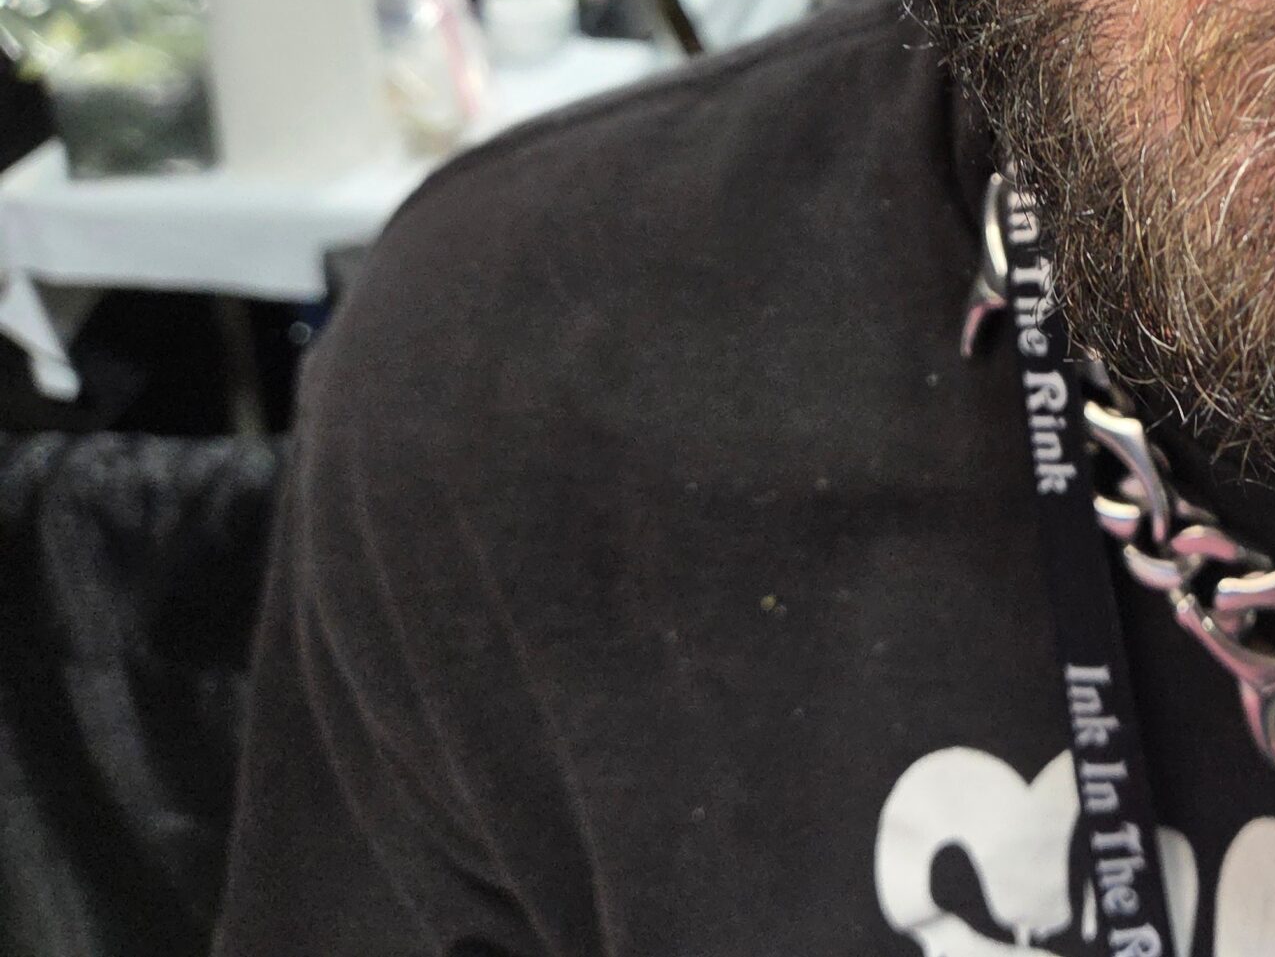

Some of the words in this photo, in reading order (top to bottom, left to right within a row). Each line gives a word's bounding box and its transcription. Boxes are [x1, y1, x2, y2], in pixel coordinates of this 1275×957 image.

[1022, 369, 1077, 493] Rink
[1064, 663, 1121, 747] Ink
[1080, 760, 1128, 814] In
[1091, 822, 1146, 916] The
